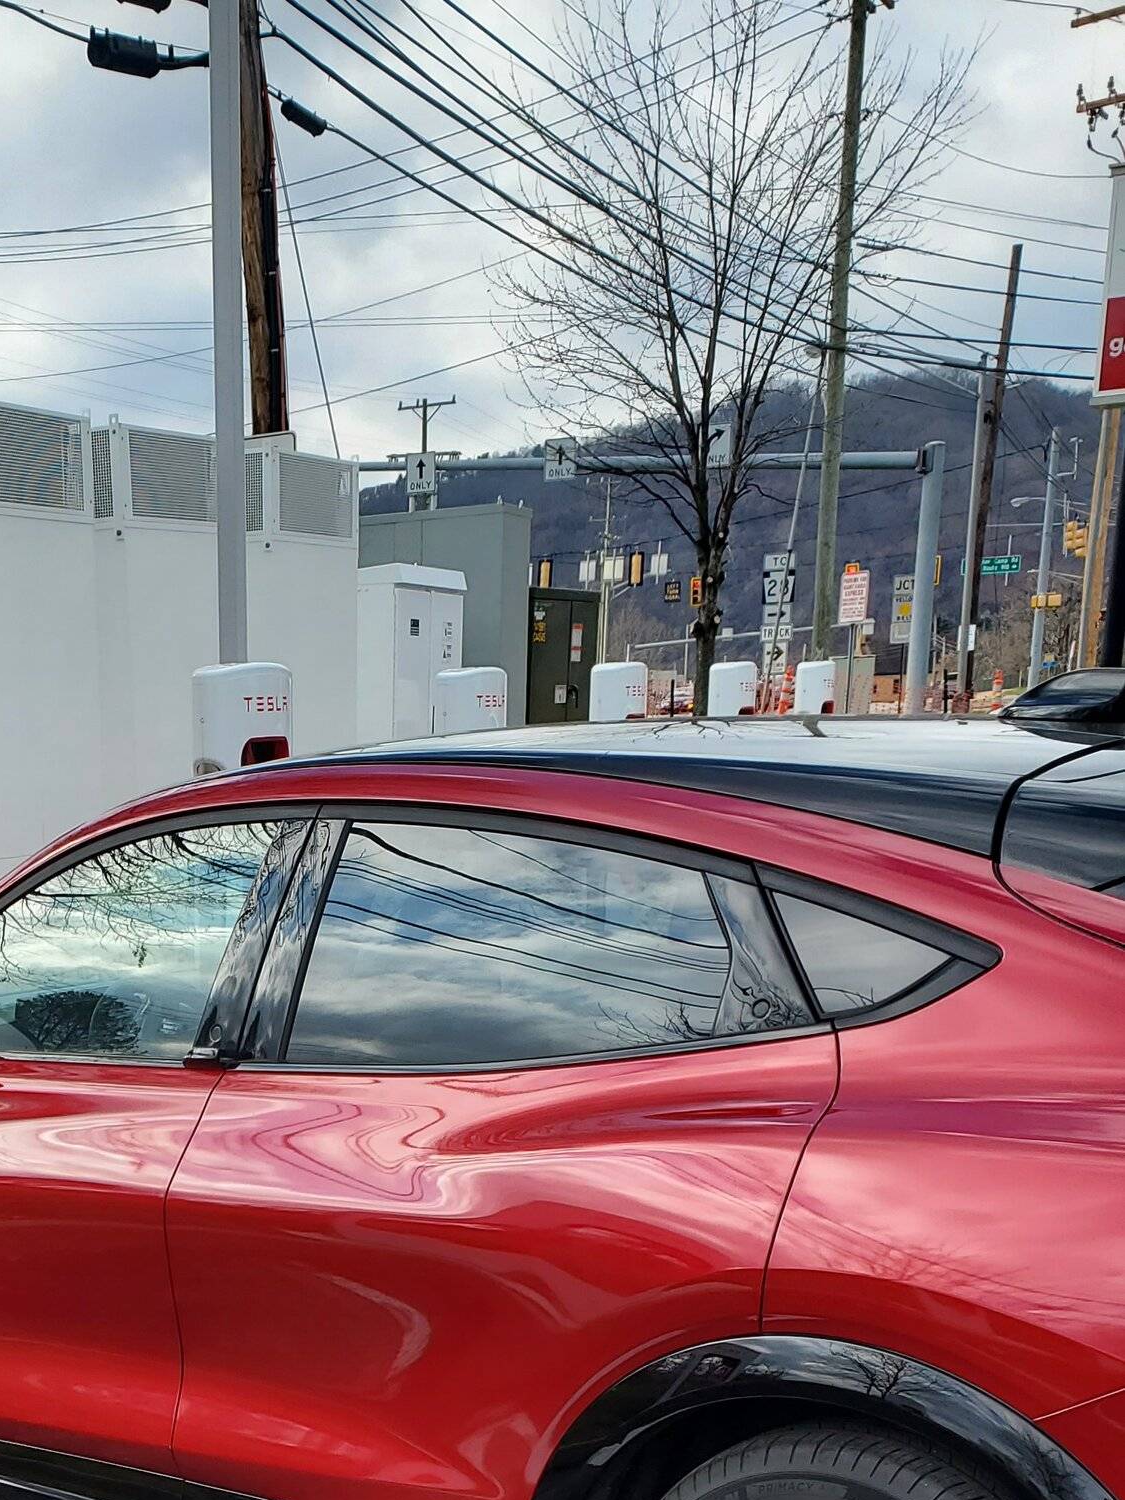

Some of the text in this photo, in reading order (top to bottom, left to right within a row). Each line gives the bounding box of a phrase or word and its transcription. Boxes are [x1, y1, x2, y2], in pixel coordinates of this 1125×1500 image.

[708, 454, 726, 463] NLY
[548, 467, 572, 478] ONLY
[410, 480, 432, 491] ONLY
[895, 580, 915, 590] JCT
[763, 628, 790, 638] TRCK
[243, 696, 288, 712] TESLA
[759, 1479, 813, 1495] PRIMACY
